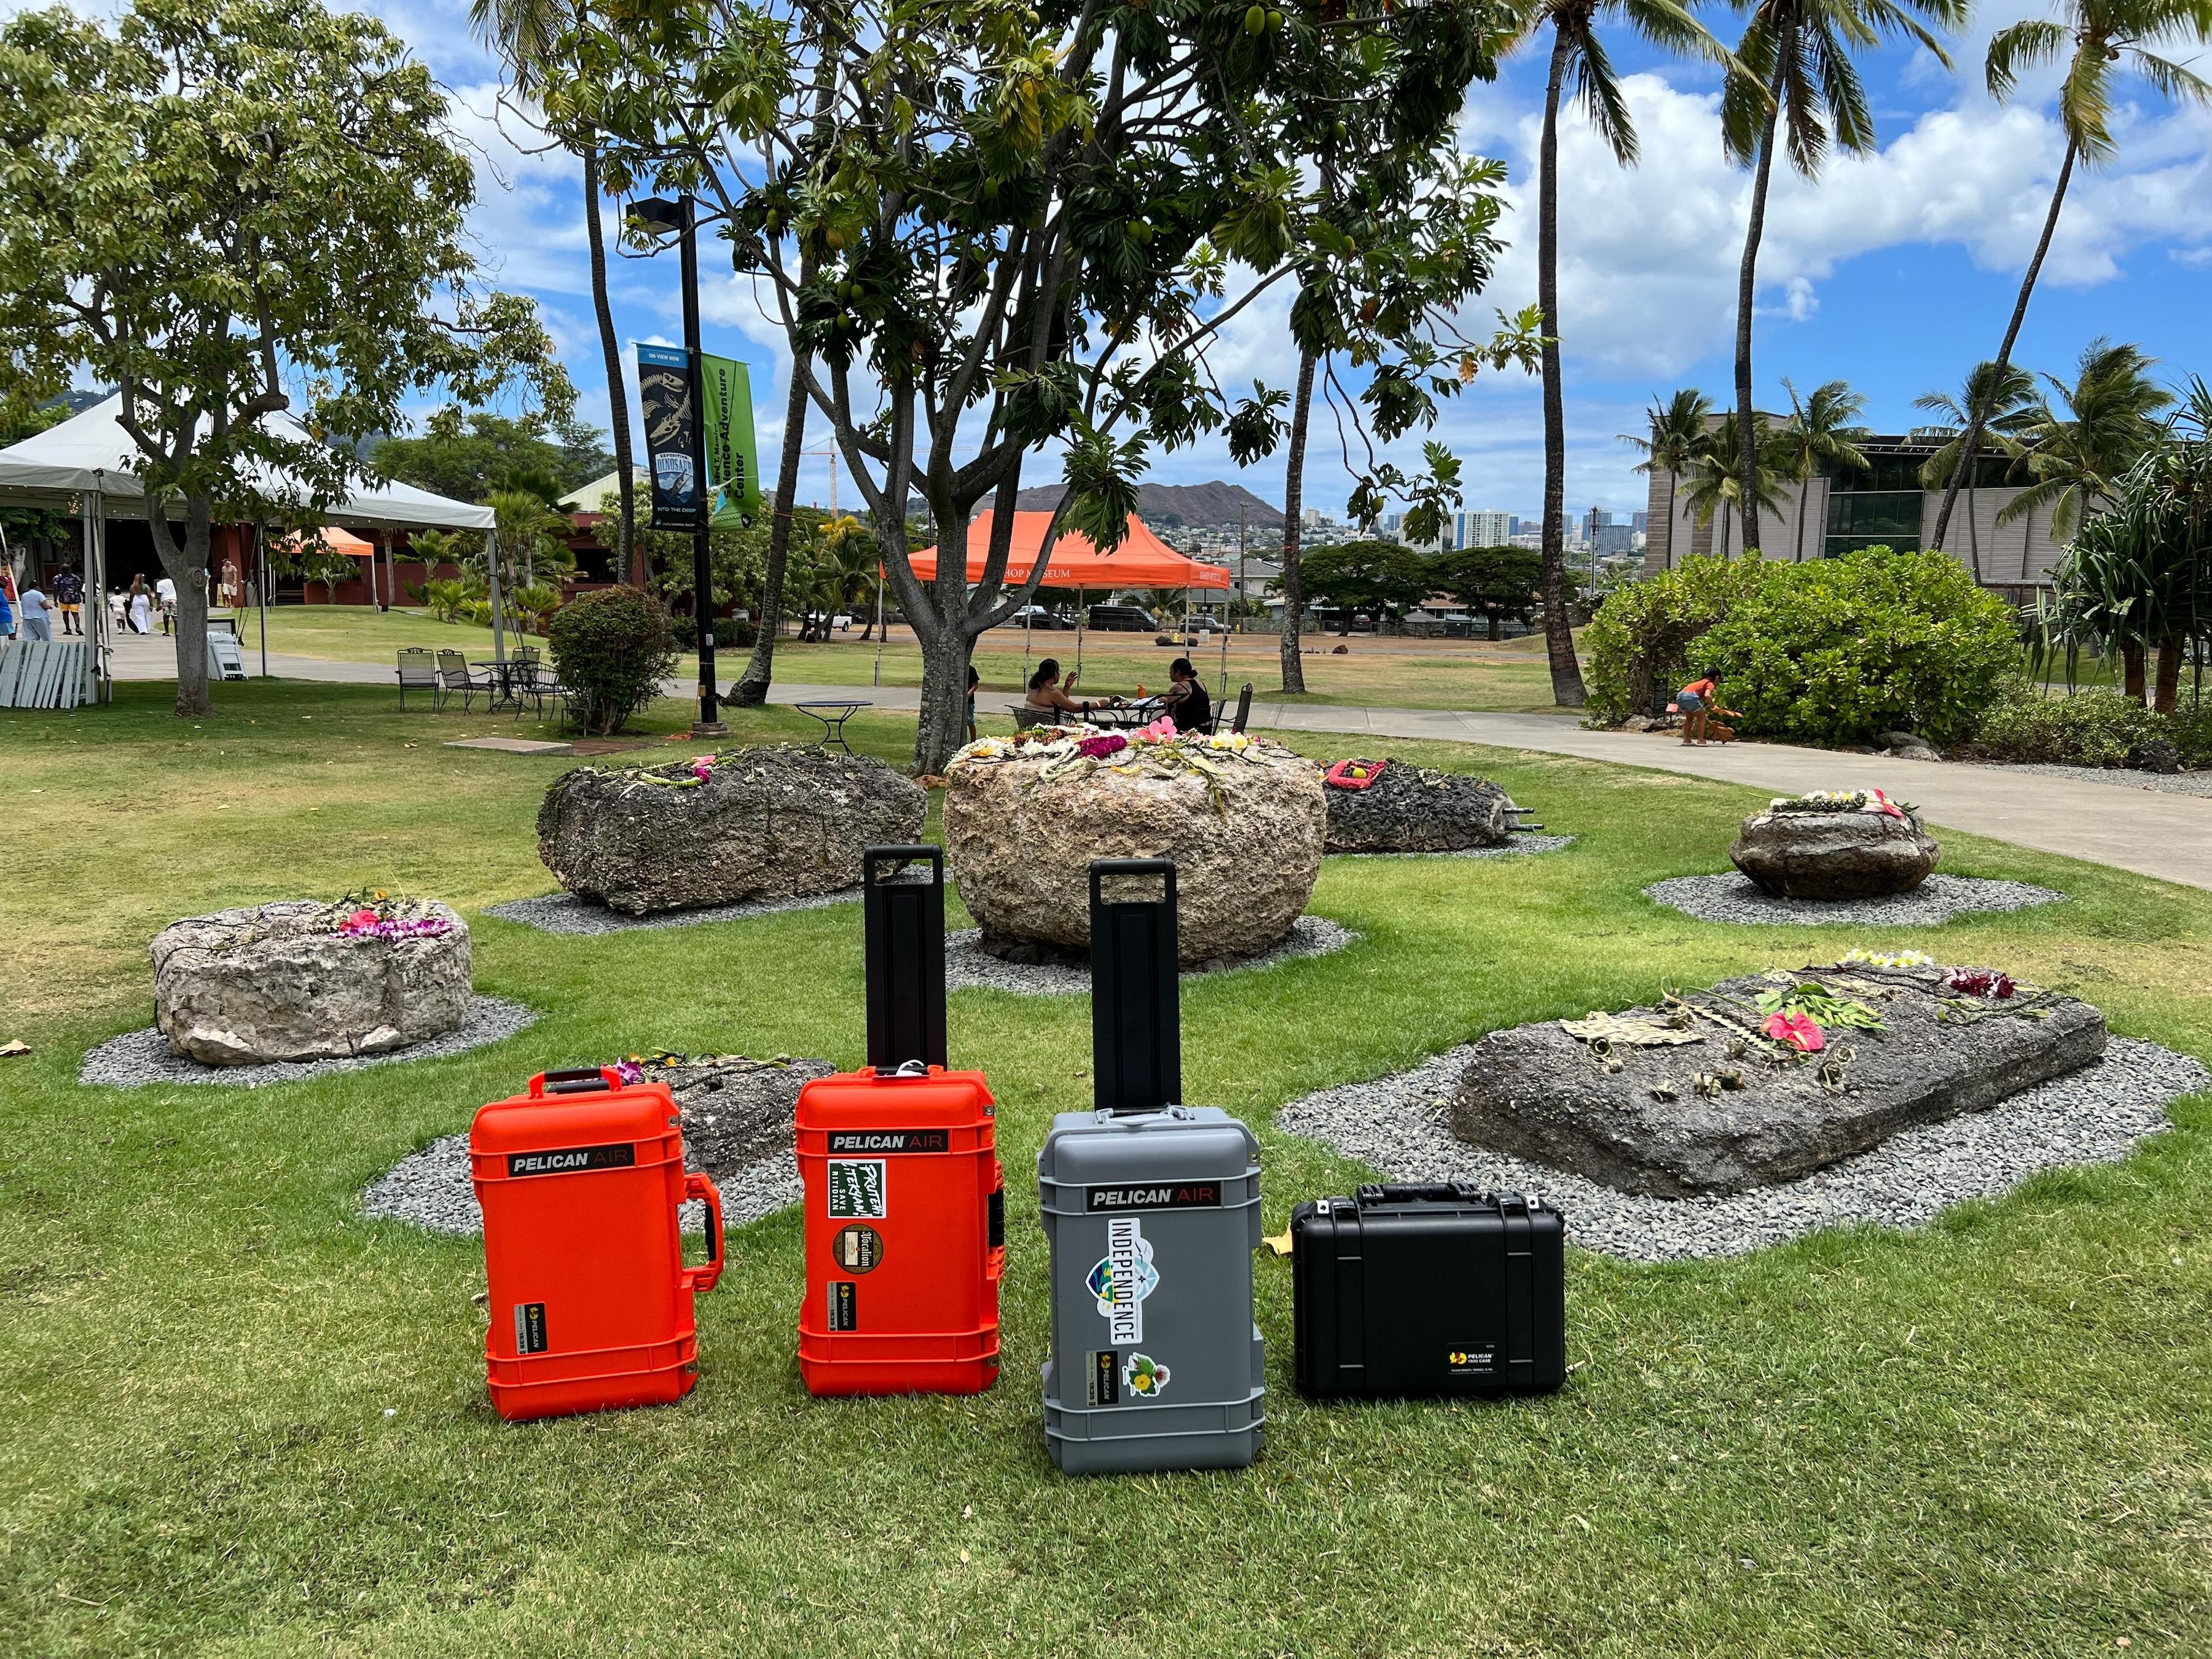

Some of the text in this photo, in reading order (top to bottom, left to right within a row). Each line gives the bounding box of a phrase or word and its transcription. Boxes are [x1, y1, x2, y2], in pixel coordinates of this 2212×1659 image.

[719, 369, 729, 441] Adventure
[657, 458, 692, 474] DINOSAUR
[734, 452, 744, 499] Center
[1005, 569, 1070, 578] HOP MSEUM
[833, 1135, 943, 1148] PELICAN AIR
[514, 1150, 629, 1172] PELICAN AIR
[1093, 1187, 1214, 1206] PELICAN AIR
[861, 1231, 873, 1266] Vocalion
[1112, 1222, 1134, 1340] INDEPENDENCE
